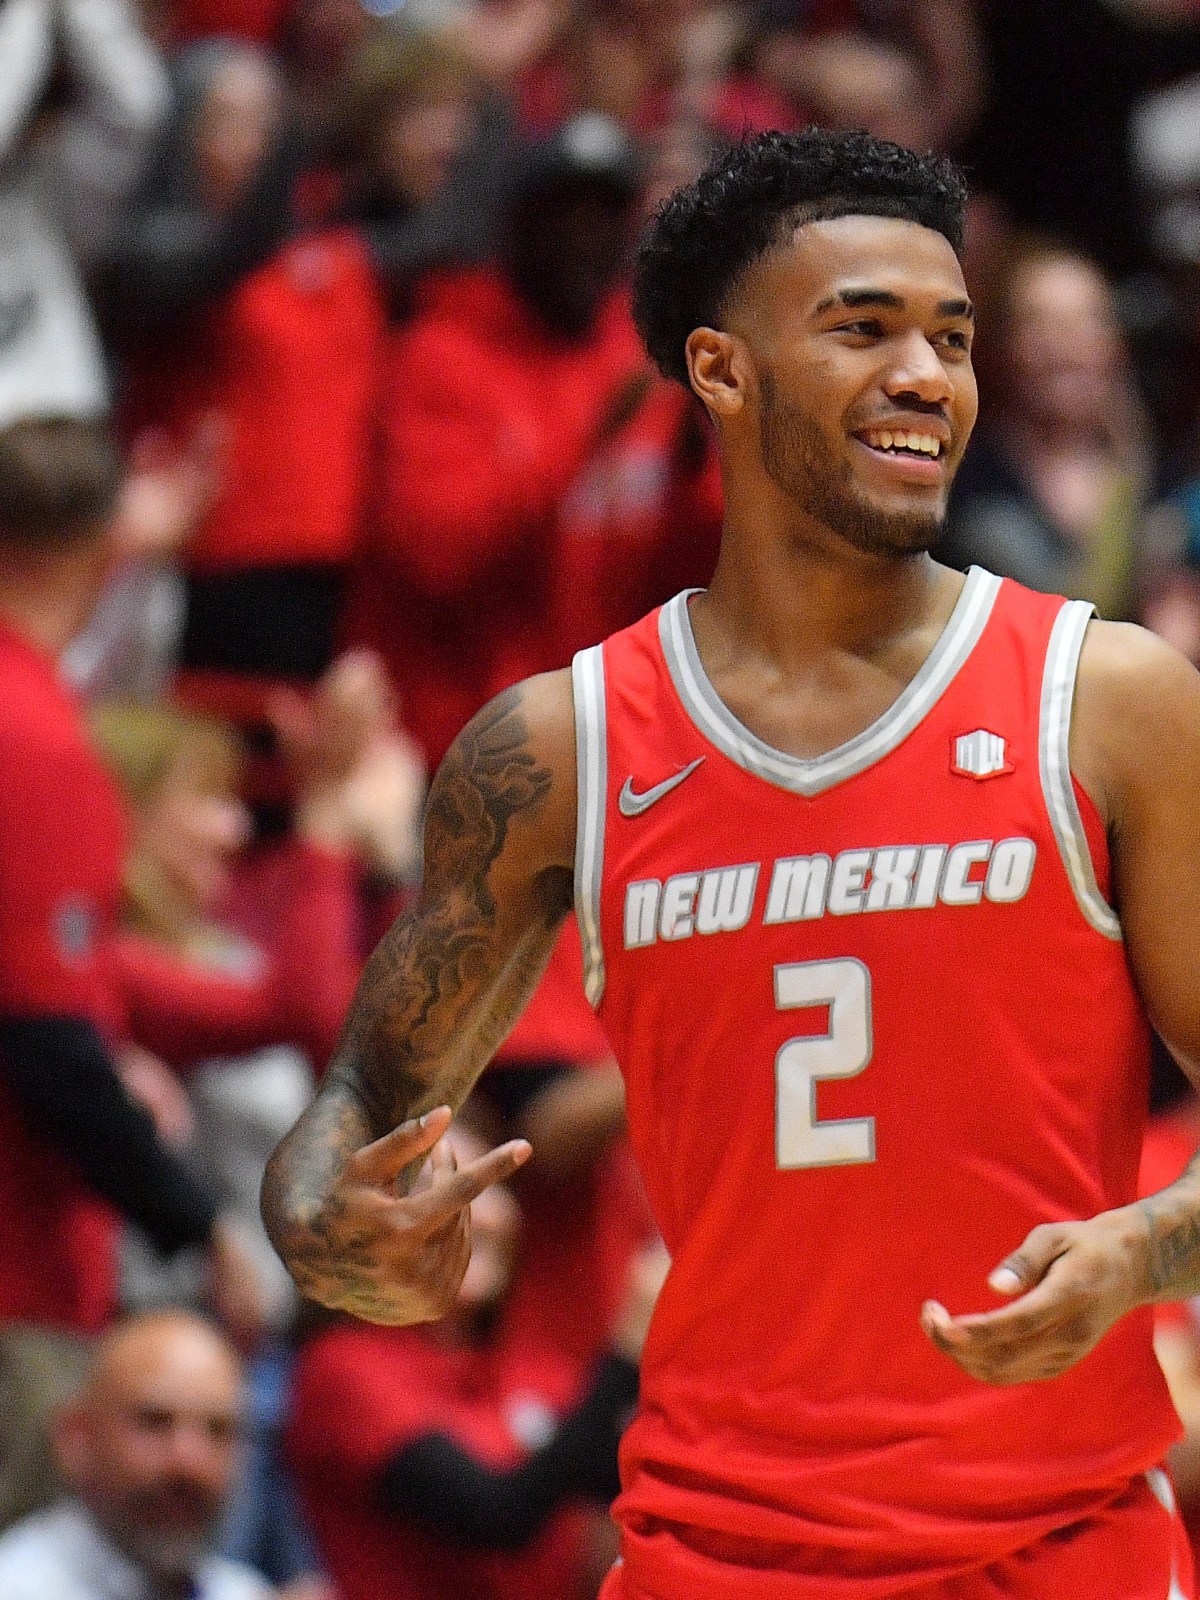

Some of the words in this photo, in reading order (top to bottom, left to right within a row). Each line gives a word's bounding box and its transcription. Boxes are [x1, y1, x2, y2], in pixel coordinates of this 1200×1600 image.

[623, 862, 761, 951] NEW
[762, 837, 1037, 925] MEXICO
[774, 956, 877, 1170] 2
